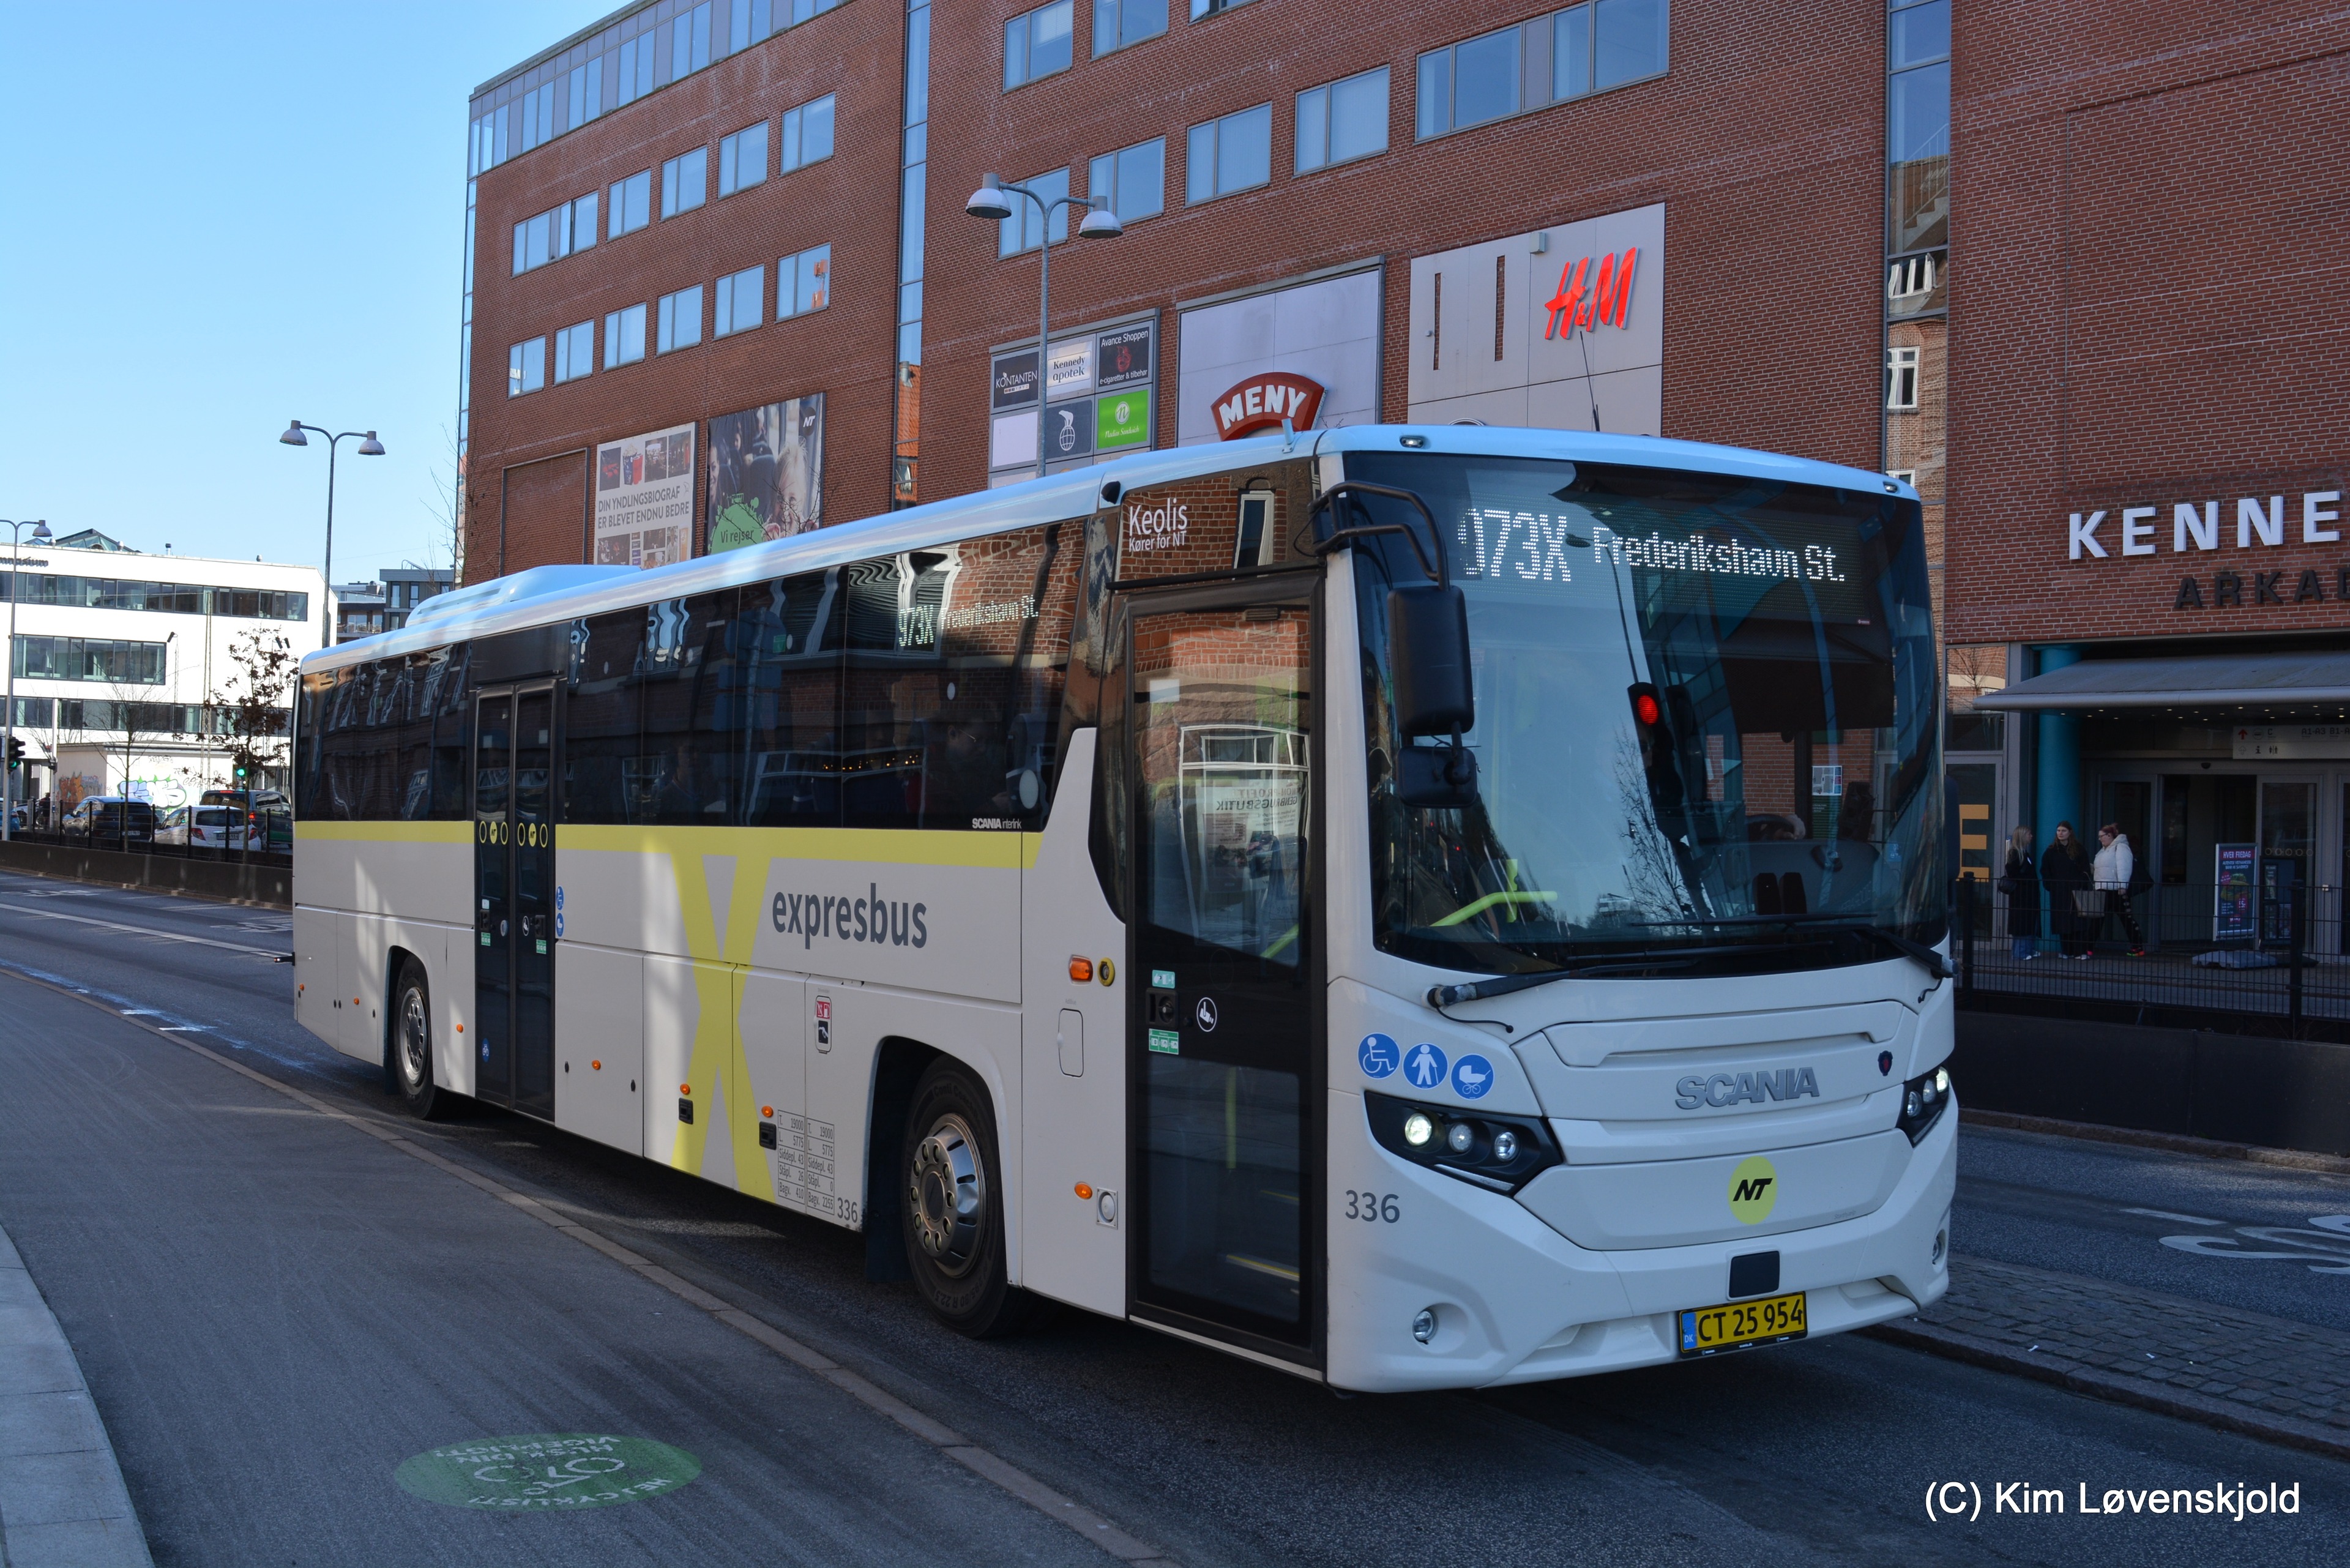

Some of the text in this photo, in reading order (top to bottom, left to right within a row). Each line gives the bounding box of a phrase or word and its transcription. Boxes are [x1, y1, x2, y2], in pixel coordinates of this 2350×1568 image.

[1544, 247, 1639, 340] H&M
[1101, 330, 1148, 348] Avance Shoppen
[1053, 357, 1086, 370] Kennedy
[996, 370, 1037, 389] KONTANTEN
[1053, 366, 1085, 383] apotek
[1099, 374, 1124, 385] e-cigaretter
[1130, 368, 1148, 378] tilbehør
[1219, 384, 1307, 431] MENY
[804, 416, 815, 428] NT
[599, 486, 680, 512] DIN YNDLINGSBIOGRAF
[598, 501, 689, 529] ER BLEVET ENDNU BEDRE
[1129, 498, 1187, 536] Keolis
[2069, 491, 2340, 560] KENNE
[721, 529, 754, 545] Vi rejser
[1129, 531, 1187, 553] Kører for NT
[1593, 527, 1799, 578] Frederikshavn
[1805, 545, 1845, 581] St.
[941, 600, 1019, 629] Frederikshavn
[972, 818, 1002, 829] SCANIA
[772, 883, 927, 949] expresbus
[1675, 1066, 1820, 1110] SCANIA
[779, 1115, 804, 1131] T. 19000
[808, 1123, 833, 1140] T. 19000
[779, 1132, 804, 1148] L. 5775
[808, 1140, 833, 1157] L. 5775
[779, 1148, 804, 1165] Siddepl. 43
[808, 1156, 833, 1174] Siddepl. 43
[779, 1164, 804, 1182] Ståpl. 26
[808, 1174, 833, 1192] Ståpl. 0
[1733, 1177, 1773, 1201] NT
[822, 1197, 833, 1210] 2255
[837, 1197, 858, 1223] 336
[1345, 1189, 1400, 1223] 336
[1684, 1298, 1803, 1343] DK CT 25 954
[456, 1452, 515, 1463] DIN
